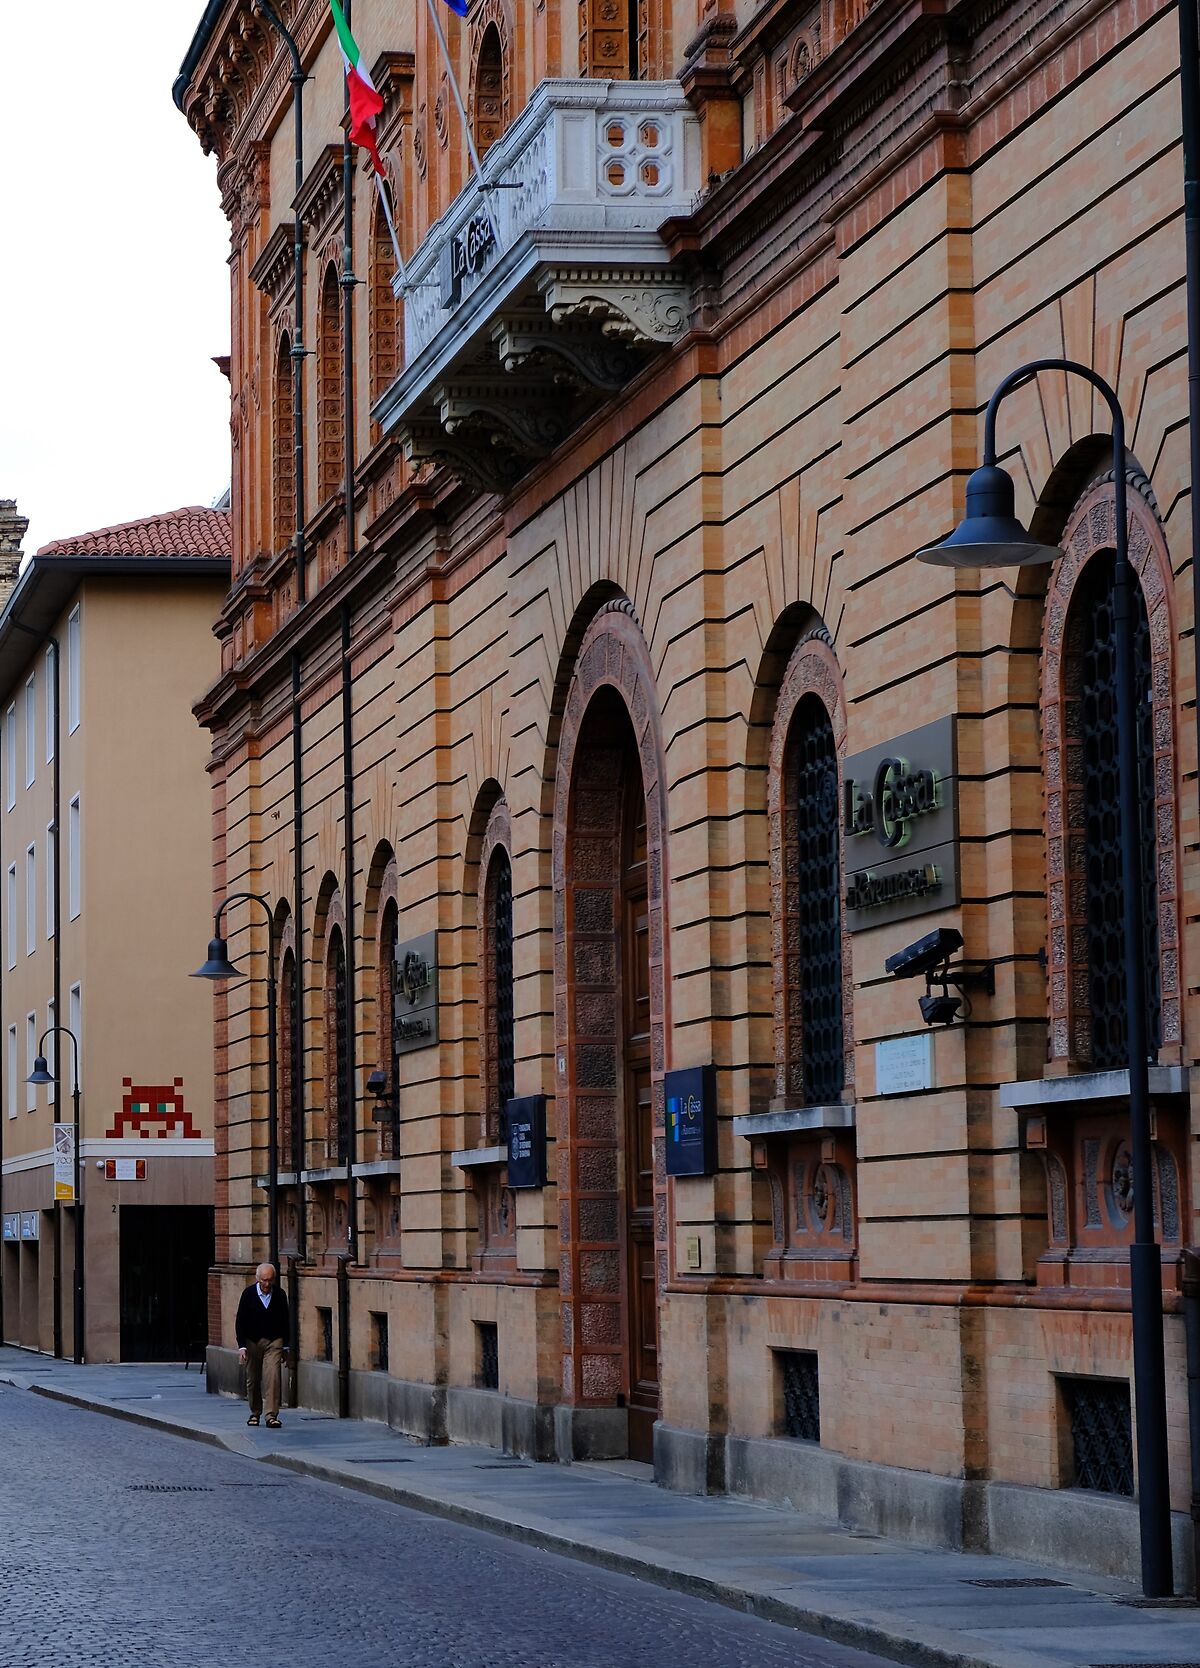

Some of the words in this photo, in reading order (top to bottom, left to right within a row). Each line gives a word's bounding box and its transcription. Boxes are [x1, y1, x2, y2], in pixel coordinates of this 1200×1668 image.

[453, 240, 466, 279] La
[465, 217, 490, 274] Cassa
[843, 777, 875, 837] La
[873, 757, 939, 849] Cassa
[680, 1097, 687, 1114] La
[112, 1205, 117, 1213] 2
